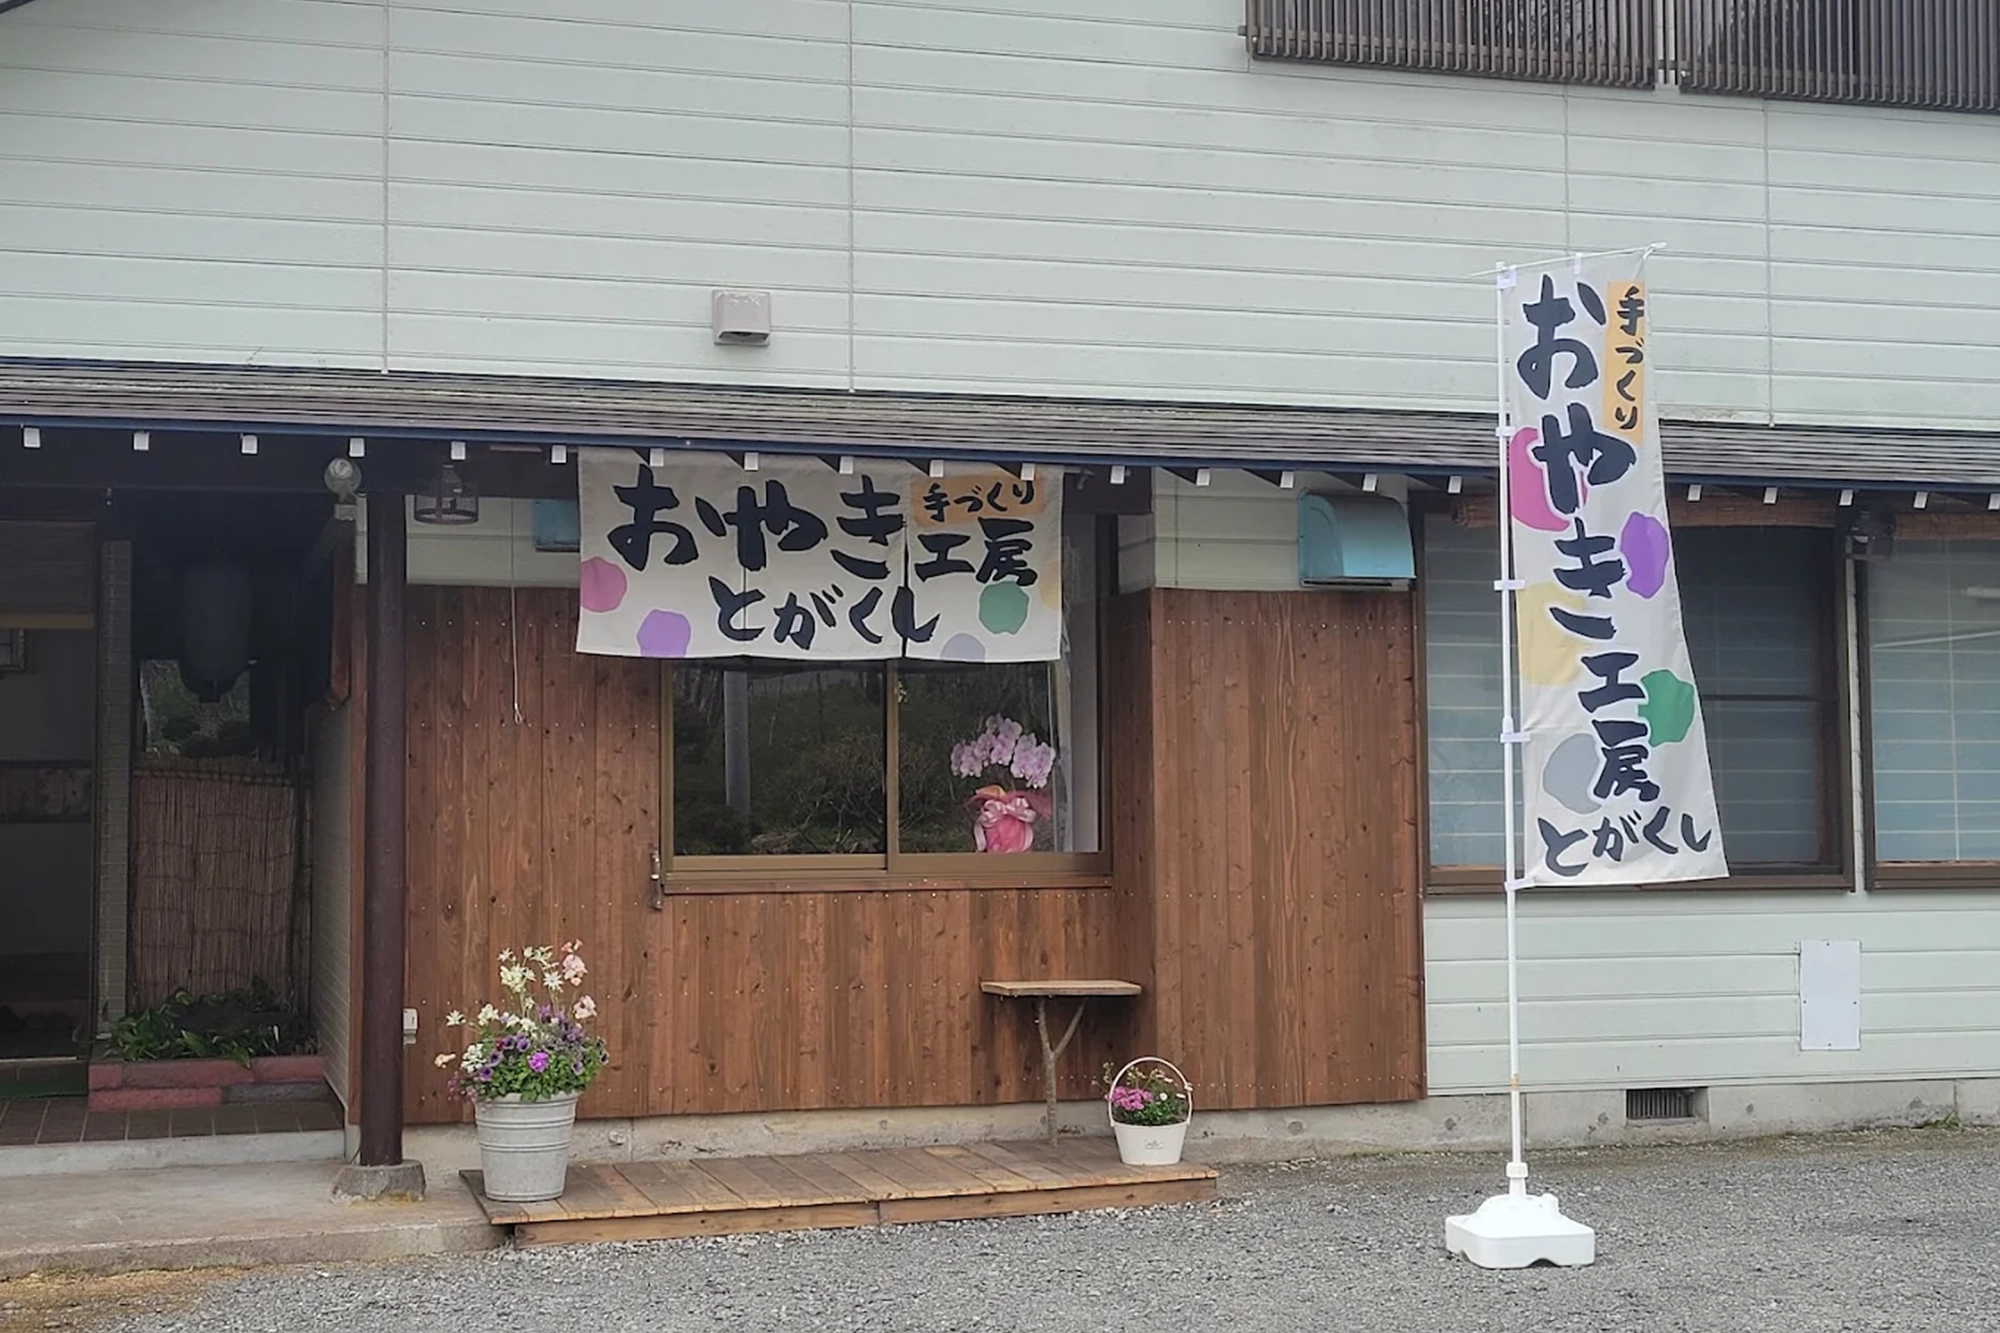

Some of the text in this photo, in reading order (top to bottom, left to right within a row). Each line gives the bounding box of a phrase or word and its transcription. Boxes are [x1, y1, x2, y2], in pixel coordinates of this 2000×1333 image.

[1614, 285, 1645, 430] 手づくり
[921, 479, 1035, 522] 手づくり
[708, 576, 941, 650] とがくし
[1537, 805, 1713, 877] とがくし
